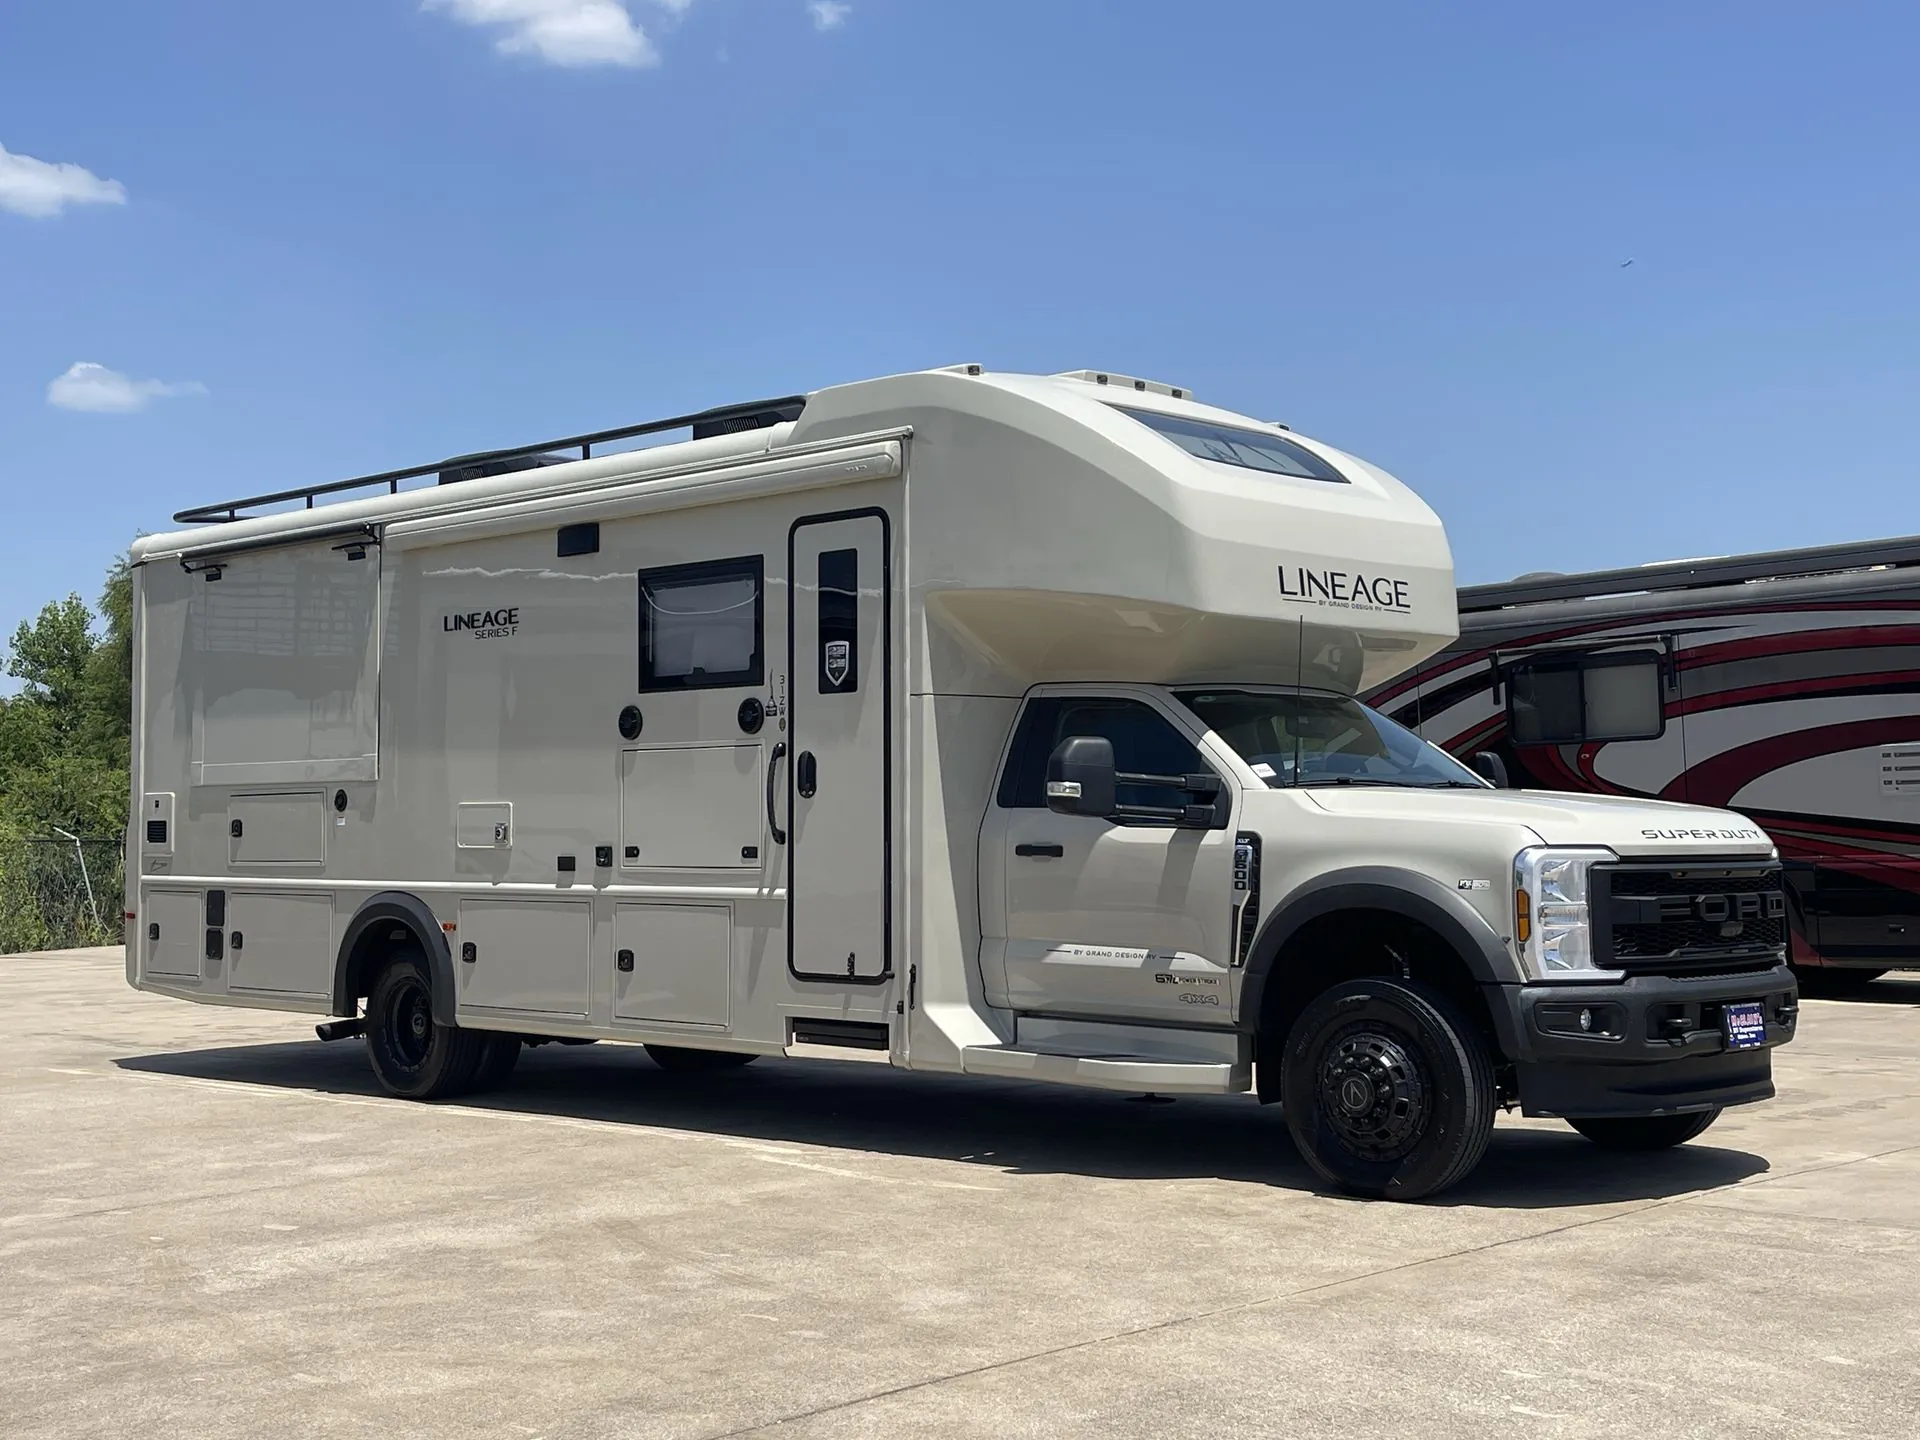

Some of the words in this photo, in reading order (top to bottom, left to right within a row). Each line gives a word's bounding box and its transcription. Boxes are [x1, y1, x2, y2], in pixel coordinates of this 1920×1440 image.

[1278, 566, 1411, 608] LINEAGE
[1352, 603, 1374, 611] DESIGN
[444, 607, 519, 632] LINEAGE
[475, 627, 509, 640] SERIES
[512, 626, 518, 636] F
[1641, 829, 1719, 839] SUPER
[1718, 829, 1761, 839] DUTY
[1115, 951, 1144, 959] DESIGN
